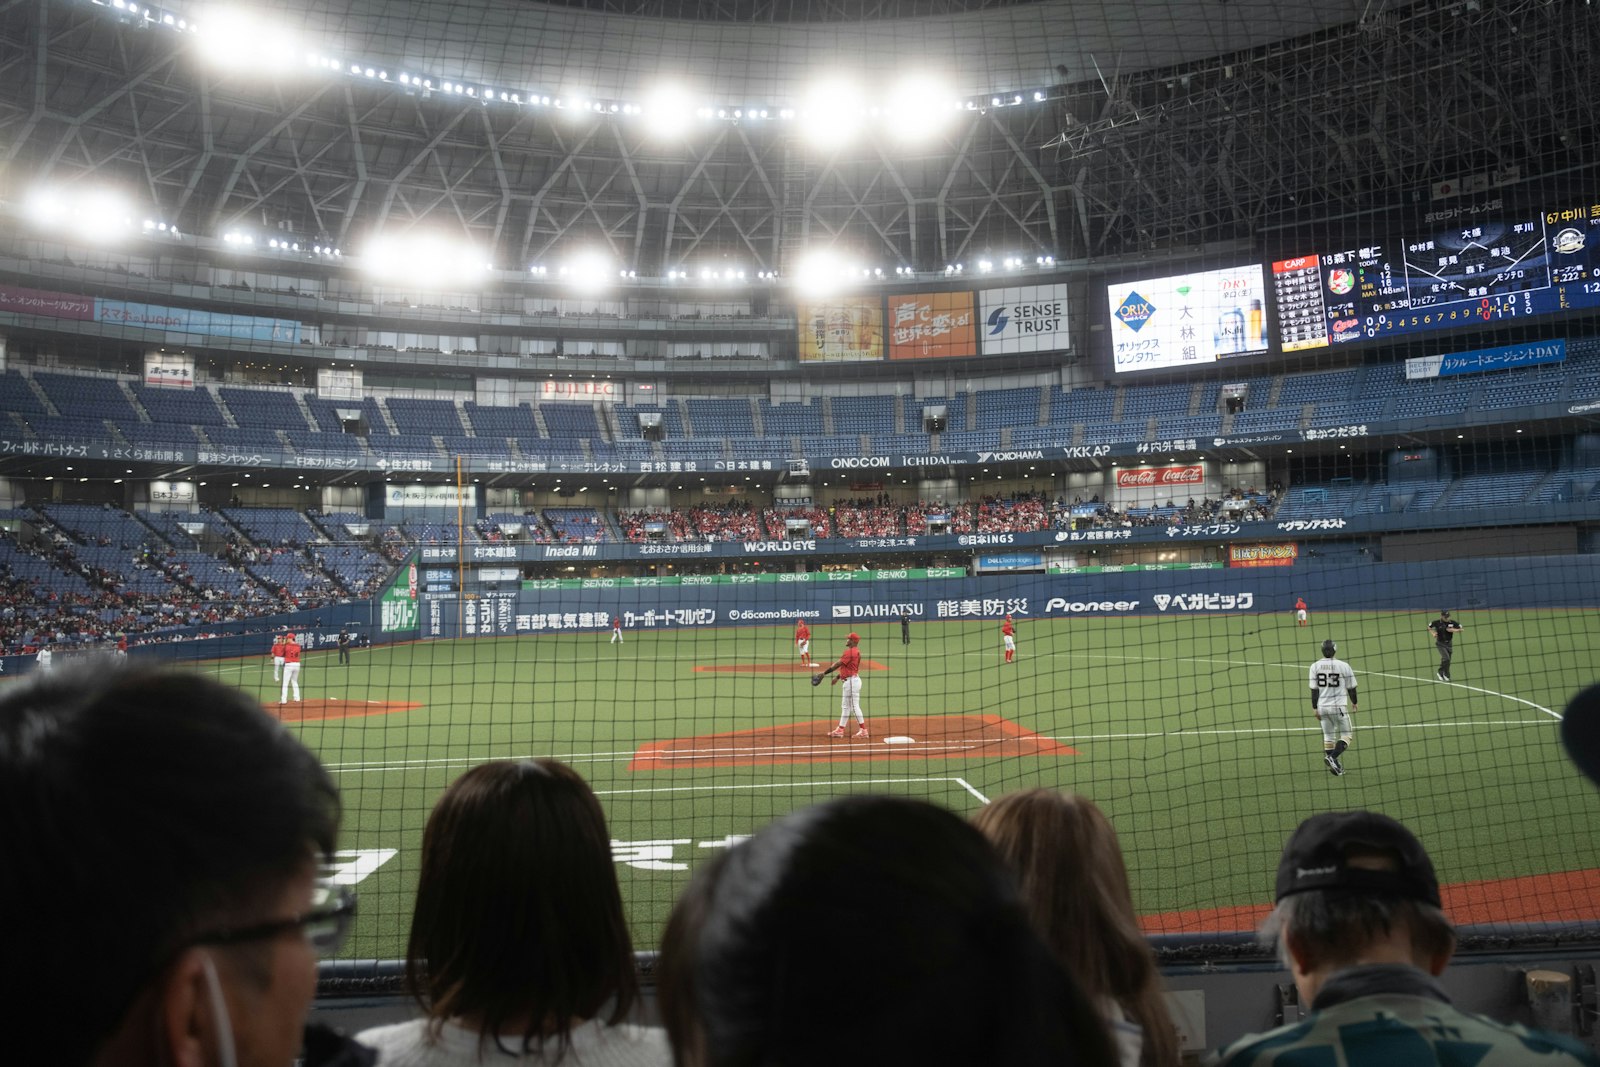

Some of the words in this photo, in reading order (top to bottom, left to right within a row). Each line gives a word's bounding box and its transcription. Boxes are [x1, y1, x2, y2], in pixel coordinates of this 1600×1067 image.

[1424, 205, 1480, 223] 京セラドーム
[1481, 199, 1503, 212] 大阪
[1546, 212, 1559, 224] 67
[1561, 206, 1586, 221] 中川
[1462, 228, 1481, 239] 大盛
[1514, 222, 1534, 234] 平川
[1322, 256, 1333, 265] 18
[1334, 250, 1356, 264] 森下
[1358, 246, 1382, 259] 暢仁
[1491, 246, 1510, 257] 菊池
[1284, 258, 1306, 269] CARP
[1438, 256, 1458, 266] 辰見
[1466, 263, 1485, 274] 森下
[1380, 271, 1391, 279] 12
[1497, 270, 1524, 282] モンテロ
[1560, 272, 1579, 282] .222
[1381, 279, 1392, 287] 18
[1432, 281, 1457, 293] 佐々木
[1468, 286, 1488, 297] 坂倉
[1391, 300, 1408, 309] 3.38
[1412, 295, 1436, 306] ファビアン
[1481, 298, 1488, 308] 0
[1495, 297, 1501, 306] 1
[1508, 295, 1516, 304] 0
[896, 302, 931, 325] 声で
[1014, 304, 1062, 318] SENSE
[1119, 303, 1150, 317] ORIX
[1483, 310, 1490, 320] 0
[1497, 309, 1502, 318] 1
[1510, 307, 1515, 316] 1
[1290, 317, 1310, 326] モンテロ
[1366, 317, 1373, 326] 0
[1375, 323, 1380, 331] 2
[1412, 317, 1418, 325] 5
[1424, 315, 1430, 324] 6
[1437, 313, 1444, 322] 7
[1450, 311, 1457, 320] 8
[1463, 309, 1470, 318] 9
[1490, 305, 1496, 313] H
[1503, 303, 1510, 311] E
[1379, 315, 1386, 324] 0
[894, 312, 971, 345] 世界を変える!
[1016, 319, 1060, 333] TRUST
[1178, 305, 1197, 360] 大林組
[1368, 328, 1374, 337] 0
[1117, 339, 1160, 352] オリックス
[1117, 352, 1161, 365] レンタカー
[544, 383, 614, 397] FUJITEC
[1306, 424, 1368, 440] 串かつだるま
[1064, 446, 1092, 458] YKK
[1093, 445, 1111, 456] AP
[1150, 439, 1197, 453] 内外電機
[114, 448, 184, 461] さくら都市開発
[198, 452, 271, 466] 東洋シャッター
[992, 450, 1043, 461] YOKOHAMA
[297, 456, 358, 468] 日本カルミック
[584, 462, 626, 472] テレネット
[640, 461, 697, 472] 西松建設
[726, 460, 771, 471] 日本建物
[832, 457, 890, 468] ONOCOM
[902, 456, 950, 466] ICHIDAI
[1120, 470, 1157, 485] Coca-Cola
[1162, 468, 1201, 482] Coca-Cola
[1285, 518, 1346, 531] グランアネスト
[968, 534, 1014, 545] 日本INGS
[1070, 530, 1132, 541] 森ノ宮医療大学
[474, 547, 516, 558] 村本建設
[545, 546, 580, 557] Inada
[582, 545, 597, 556] Mi
[640, 544, 712, 554] 北おおさか信用金庫
[583, 579, 614, 588] SENKO
[633, 578, 662, 586] センコー
[682, 577, 712, 585] SENKO
[731, 575, 760, 583] センコー
[779, 573, 810, 582] SENKO
[828, 572, 858, 580] センコー
[876, 570, 907, 579] SENKO
[926, 569, 956, 577] センコー
[853, 603, 923, 617] DAIHATSU
[937, 598, 1029, 617] 能美防災
[1045, 598, 1140, 612] Pioneer
[480, 599, 491, 633] エコリカ
[498, 598, 508, 632] エタニティ
[624, 608, 715, 627] カーポートマルゼン
[741, 610, 779, 620] docomo
[781, 608, 820, 618] Business
[516, 612, 609, 630] 西部電気建設
[1317, 673, 1340, 687] 83
